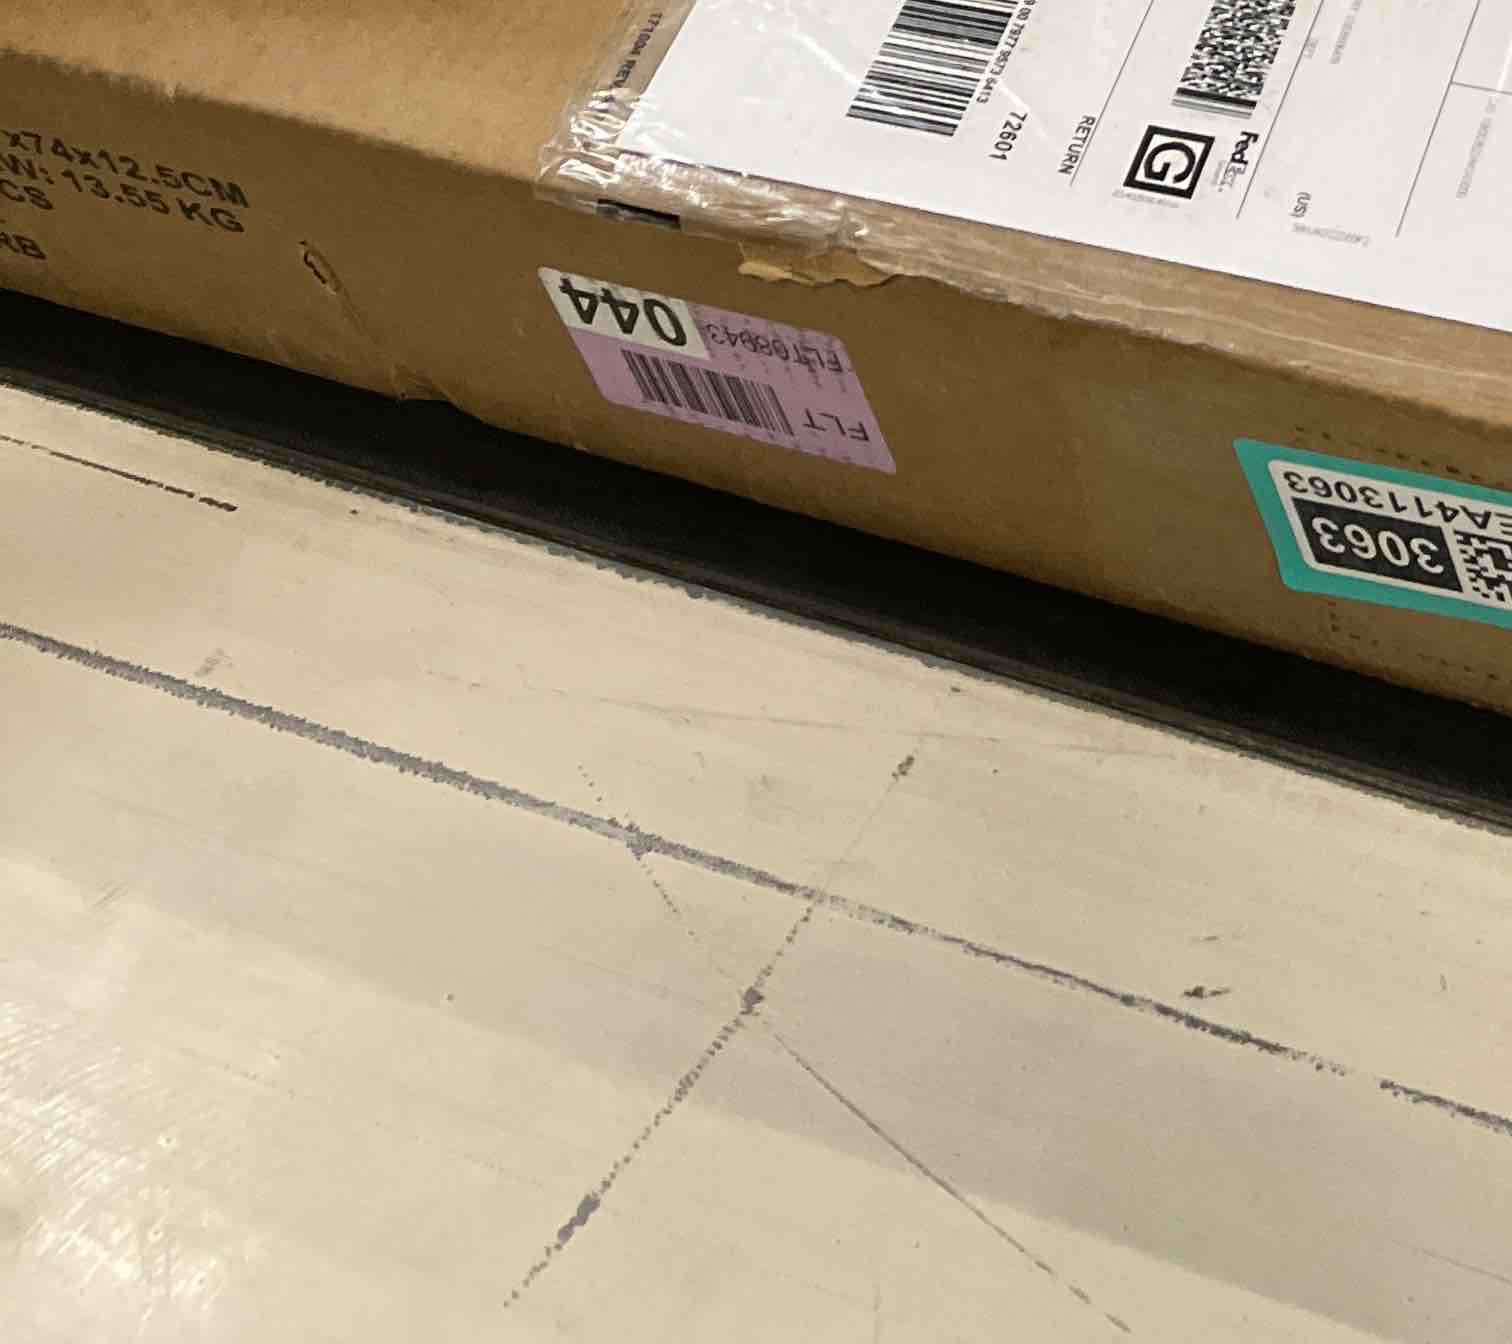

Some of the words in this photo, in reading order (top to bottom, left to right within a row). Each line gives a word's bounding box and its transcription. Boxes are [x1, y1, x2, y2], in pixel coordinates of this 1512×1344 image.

[987, 110, 1027, 161] 72601
[1057, 115, 1095, 174] RETURN
[1143, 141, 1196, 185] G
[61, 170, 171, 215] 13.55
[176, 198, 244, 233] KG
[1288, 190, 1313, 218] (US)
[559, 277, 687, 346] 044
[803, 409, 870, 441] FLT
[1311, 517, 1442, 573] 3063
